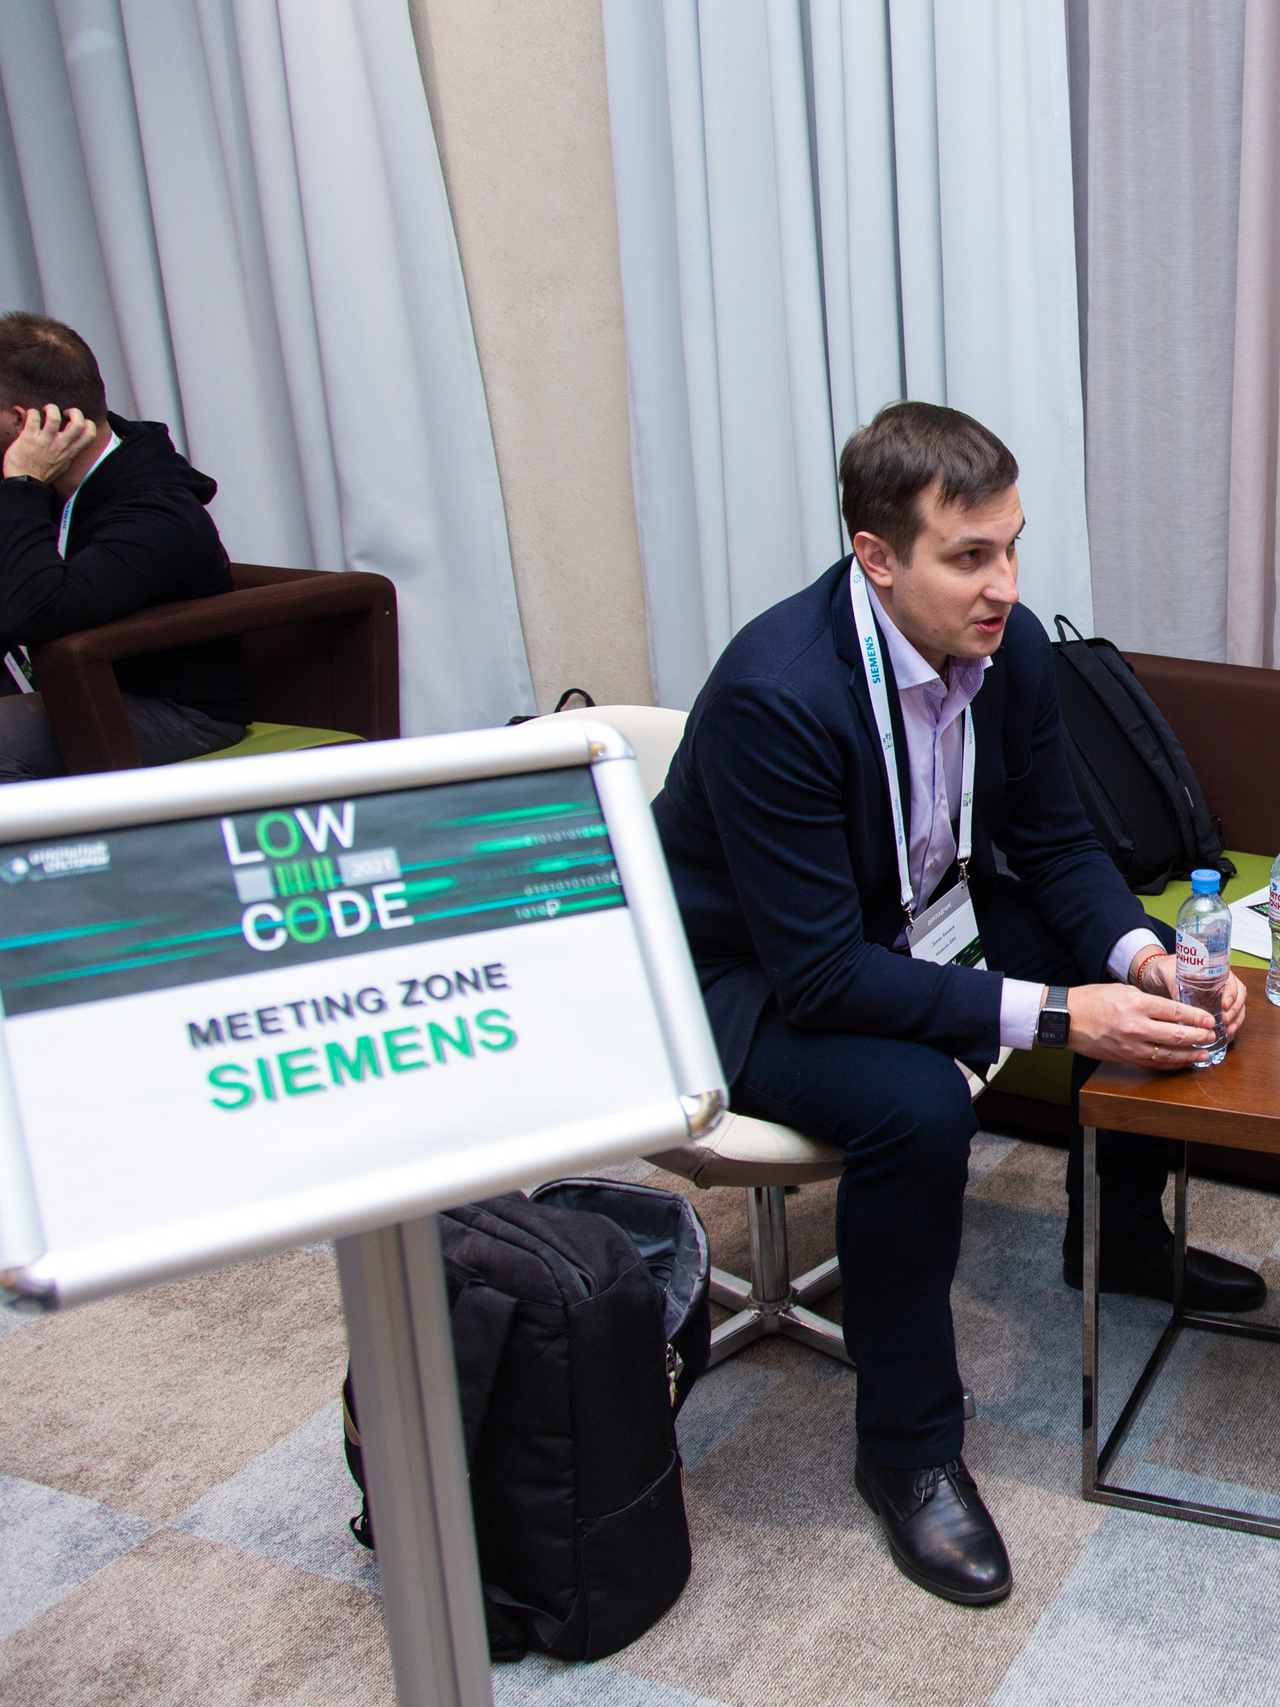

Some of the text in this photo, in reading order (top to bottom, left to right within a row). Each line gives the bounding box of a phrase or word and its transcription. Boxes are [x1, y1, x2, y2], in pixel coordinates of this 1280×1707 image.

[62, 500, 72, 530] SIEMENS
[864, 636, 881, 684] SIEMENS
[221, 801, 355, 865] LOW
[351, 858, 394, 878] 2021
[241, 881, 415, 951] CODE
[187, 962, 511, 1049] MEETING ZONE
[207, 1009, 518, 1110] SIEMENS
